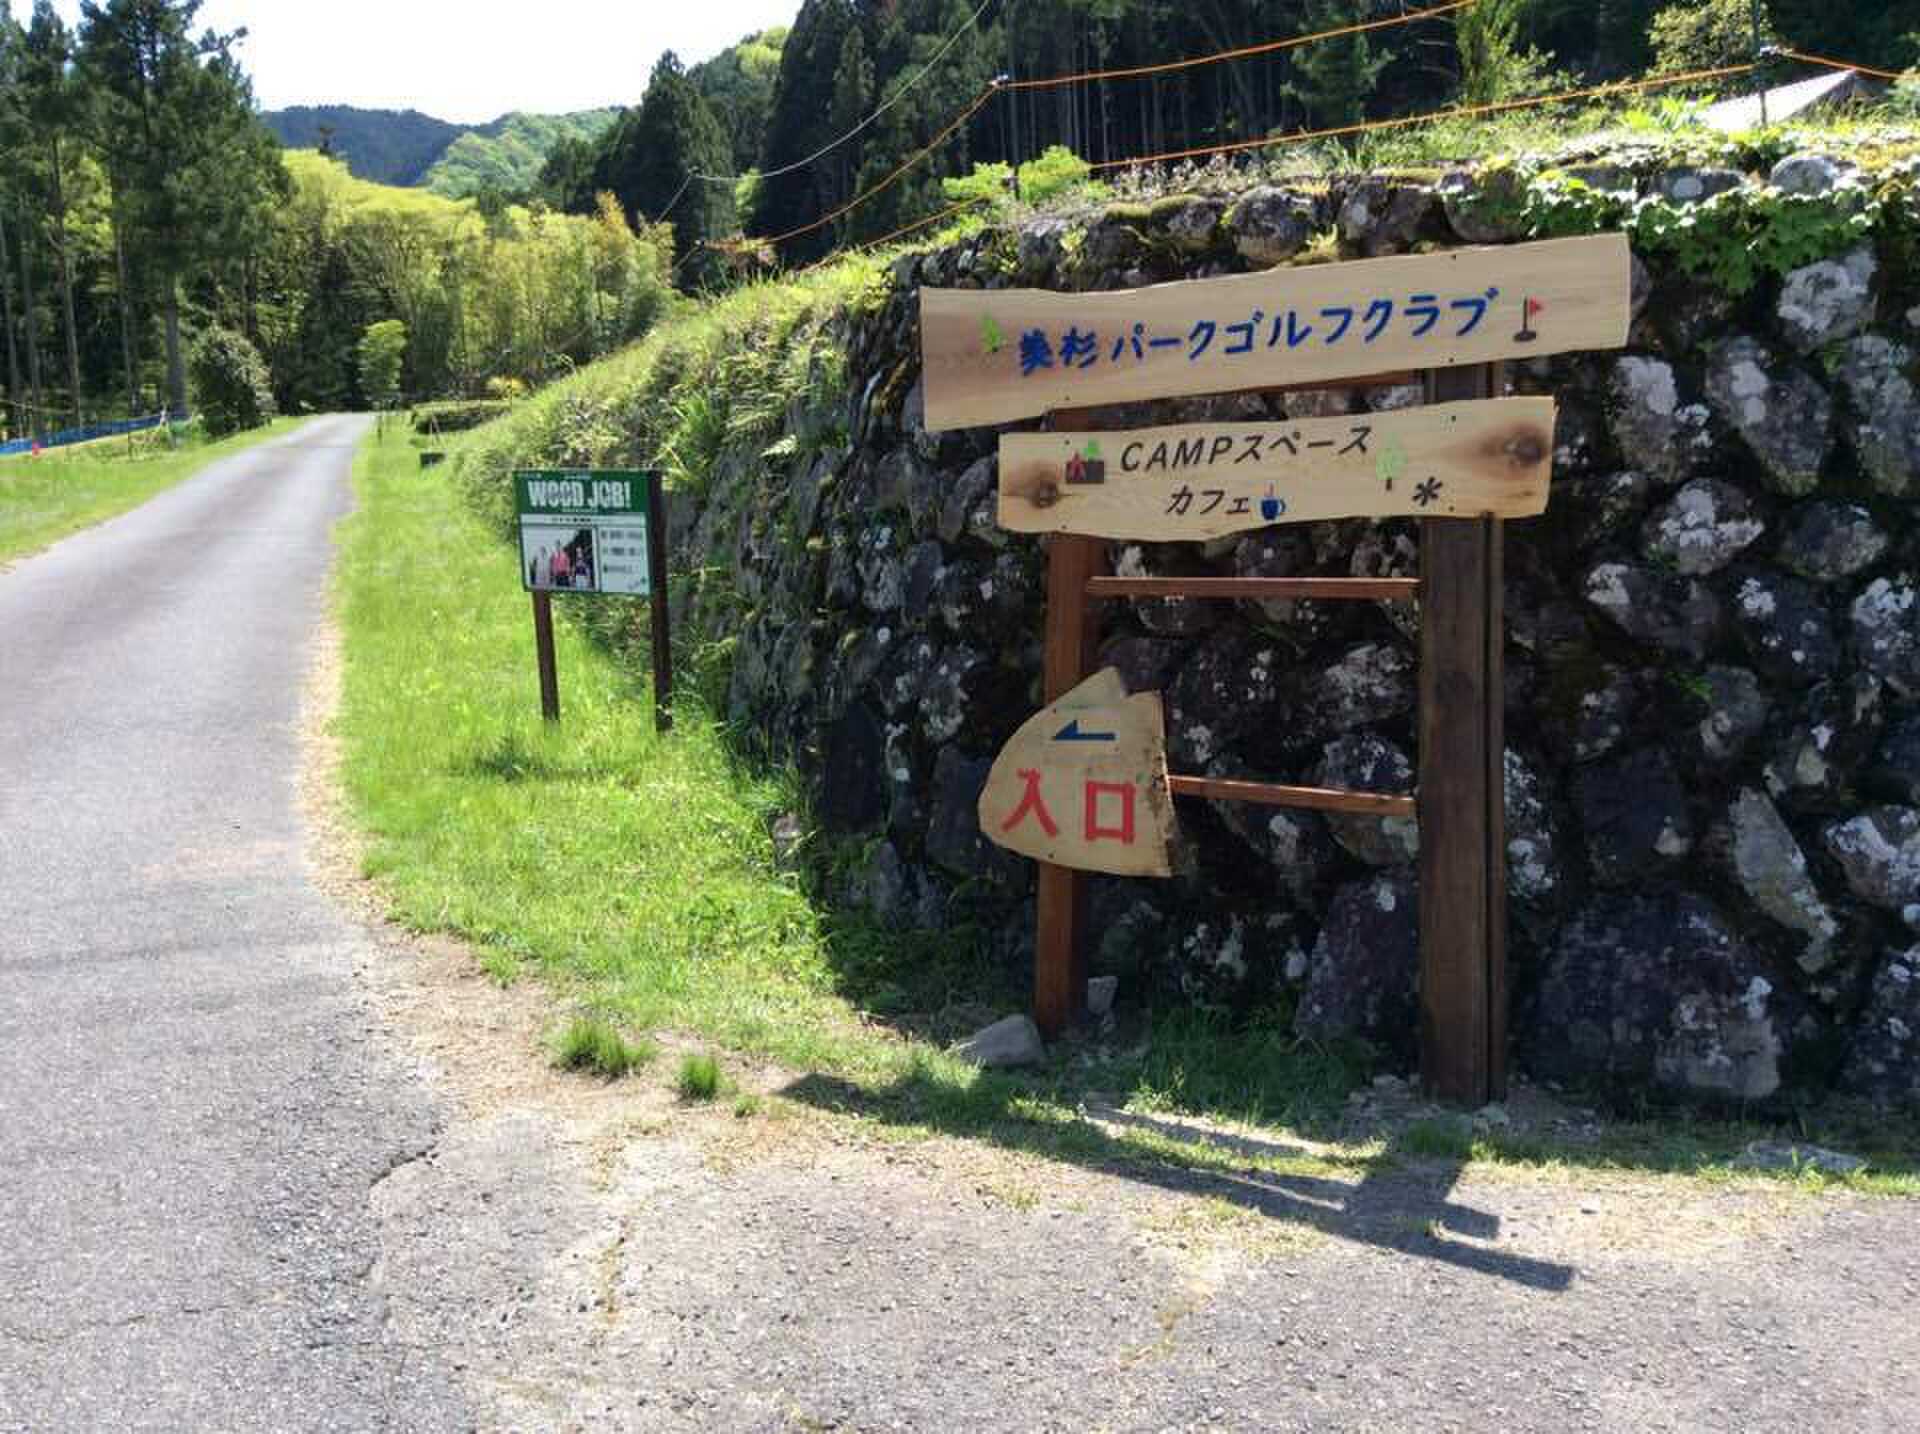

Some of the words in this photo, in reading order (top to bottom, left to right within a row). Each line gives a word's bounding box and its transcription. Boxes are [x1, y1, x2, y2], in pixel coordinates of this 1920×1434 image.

[1018, 286, 1499, 377] 美杉パークゴルフクラブ
[1120, 425, 1373, 473] CAMPスペース
[1164, 484, 1251, 518] カフェ
[1001, 768, 1137, 845] 入口
